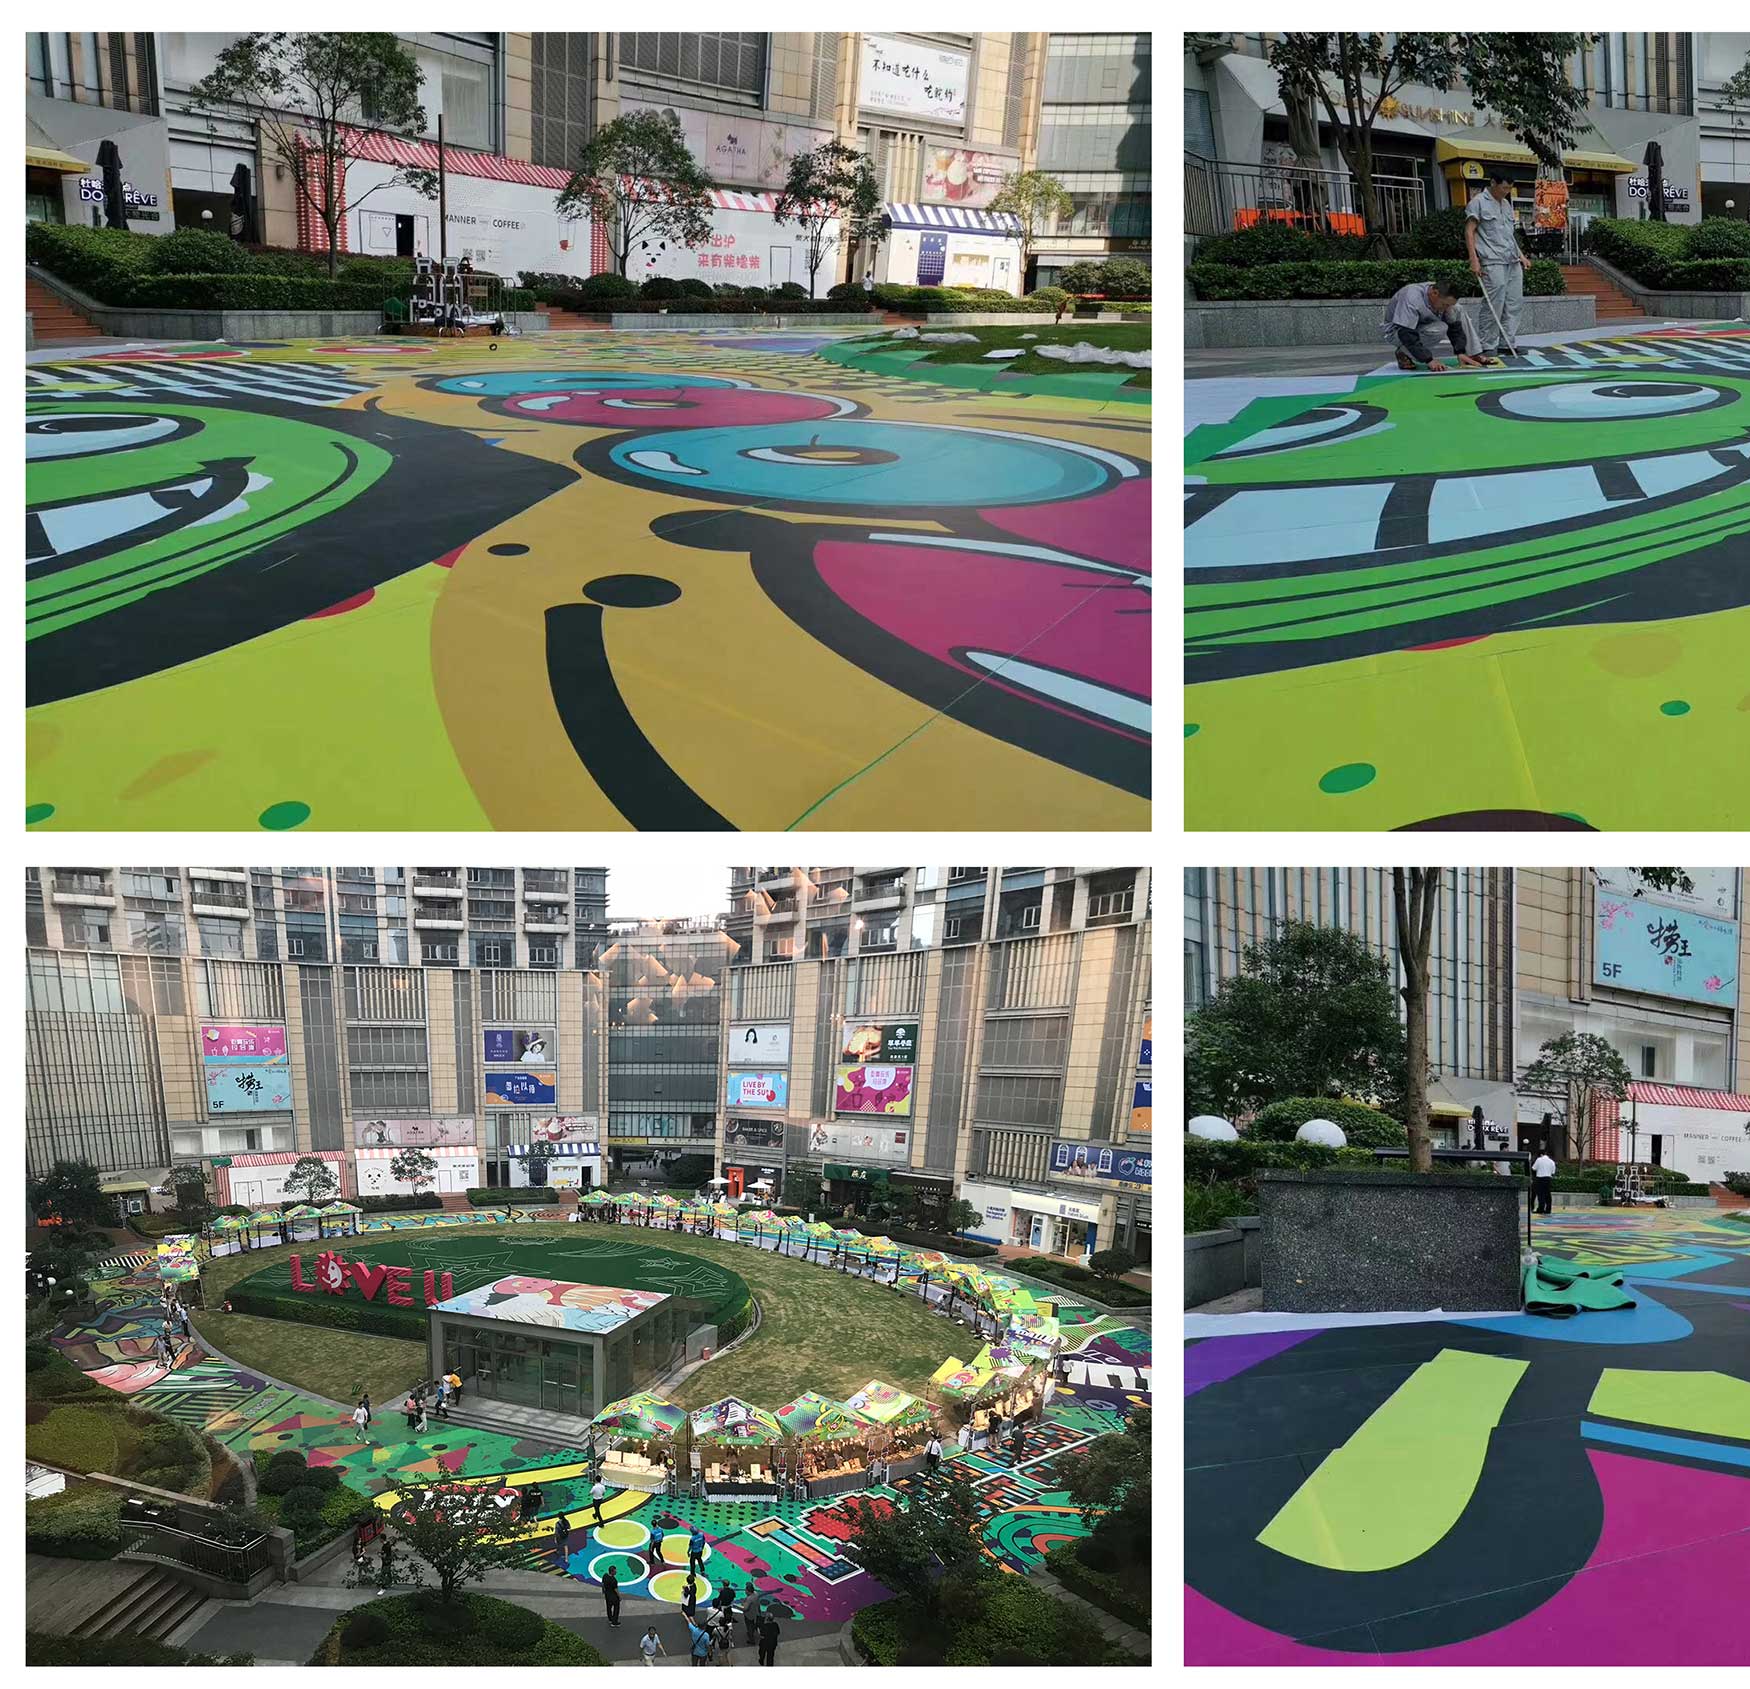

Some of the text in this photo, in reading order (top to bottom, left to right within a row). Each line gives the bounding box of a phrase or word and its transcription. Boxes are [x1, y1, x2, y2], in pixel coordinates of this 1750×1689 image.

[492, 218, 521, 230] COFFEE
[1602, 962, 1622, 978] 5F
[742, 1080, 756, 1089] LIVE
[743, 1088, 756, 1096] THE
[213, 1101, 224, 1109] 5F
